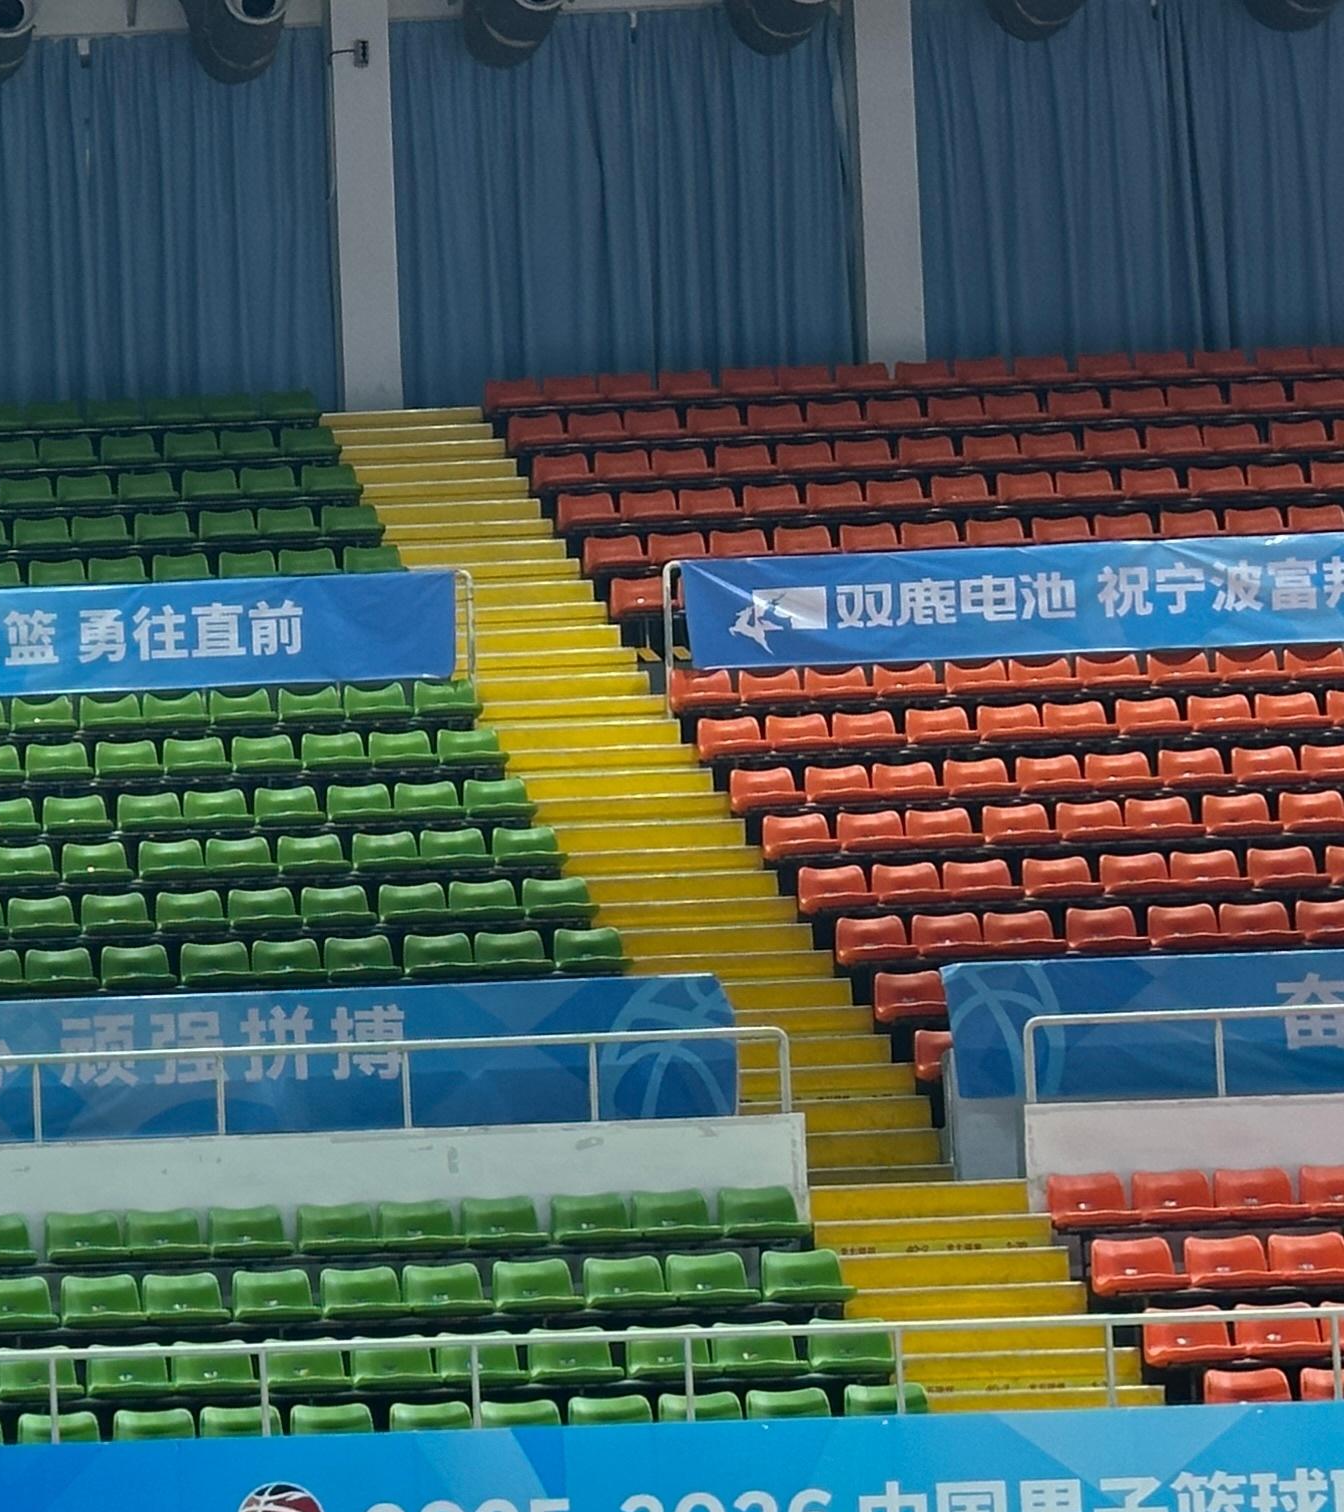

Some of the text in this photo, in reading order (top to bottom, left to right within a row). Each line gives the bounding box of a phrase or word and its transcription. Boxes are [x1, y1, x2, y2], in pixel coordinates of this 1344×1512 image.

[78, 599, 304, 664] 勇往直前
[837, 572, 1077, 630] 双鹿电池
[60, 1004, 406, 1087] 顽强拼搏
